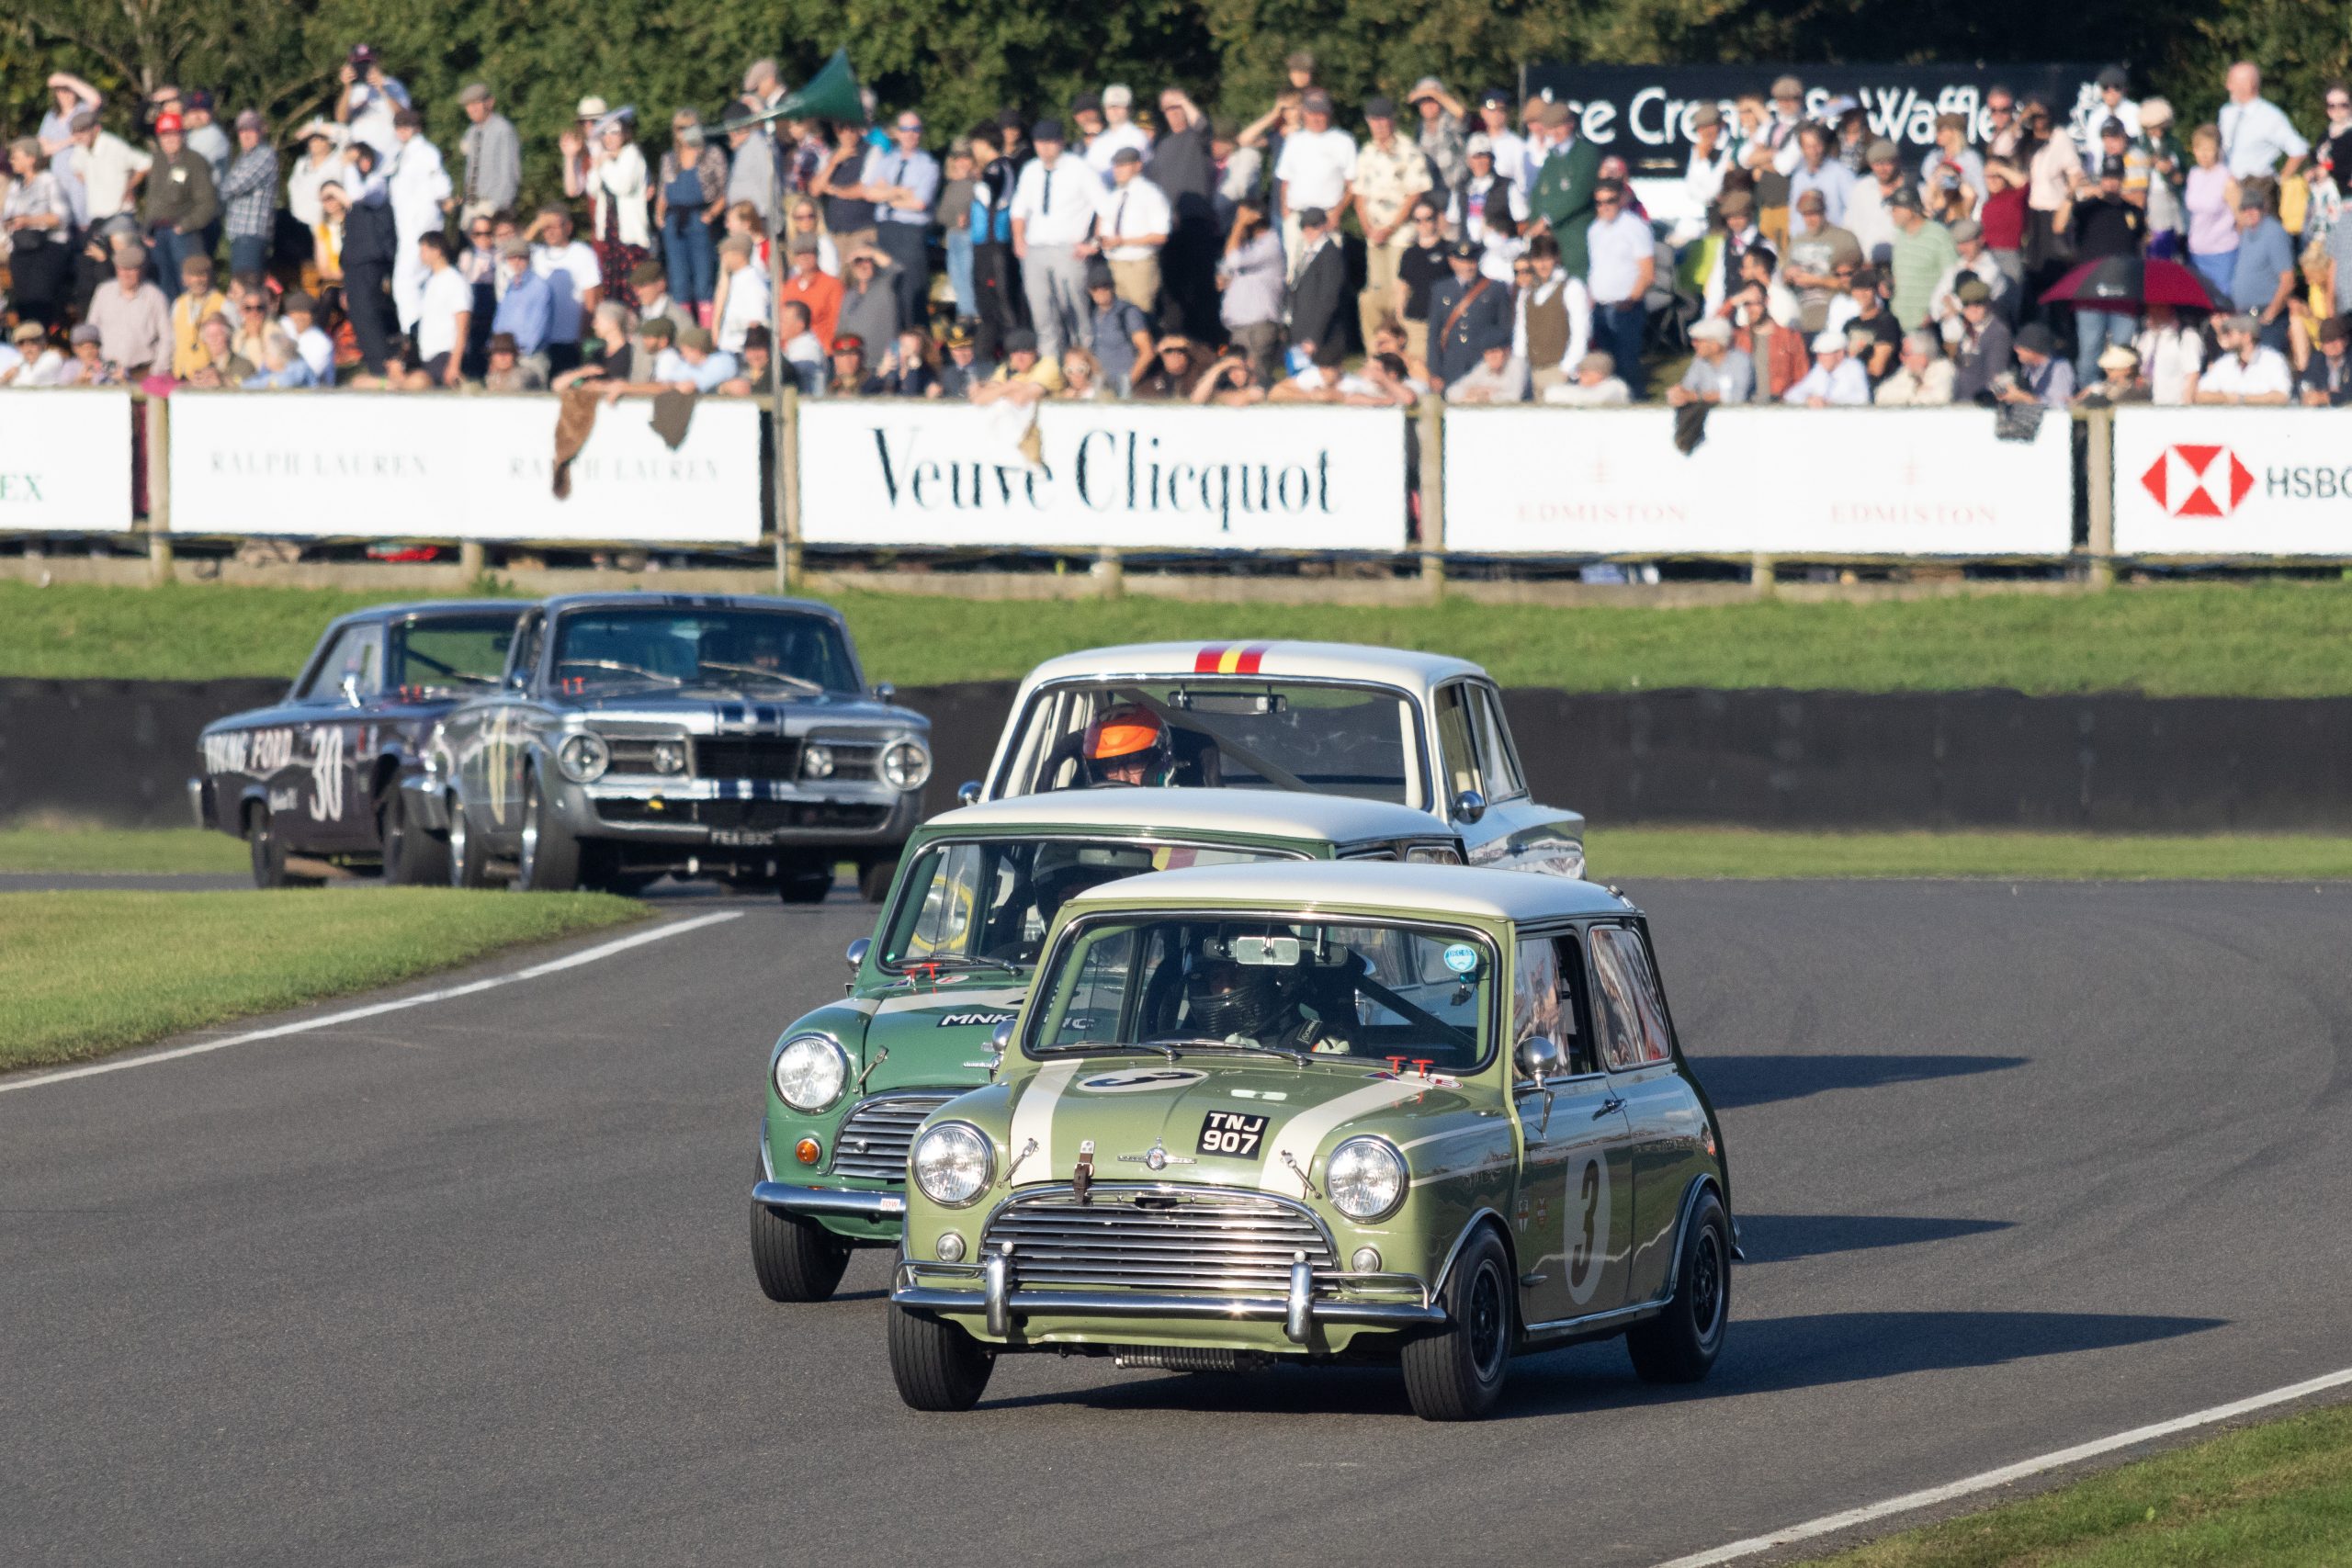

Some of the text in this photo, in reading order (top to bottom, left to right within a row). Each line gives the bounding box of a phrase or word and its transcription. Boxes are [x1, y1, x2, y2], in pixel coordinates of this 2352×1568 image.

[1629, 86, 1781, 144] Crea
[1859, 85, 2024, 144] Waffle
[210, 451, 427, 477] RALPH LAUREN
[509, 457, 599, 480] RAH
[870, 427, 1341, 533] Veuve Clicquot
[1516, 501, 1689, 524] EDMISTON
[1830, 502, 1997, 526] EDMISTON
[250, 728, 293, 769] FORD
[309, 724, 343, 822] 30
[941, 1013, 1015, 1026] MNK
[1084, 1071, 1203, 1088] 3
[1210, 1112, 1263, 1133] TNJ
[1202, 1130, 1259, 1155] 907
[1571, 1159, 1600, 1288] 3
